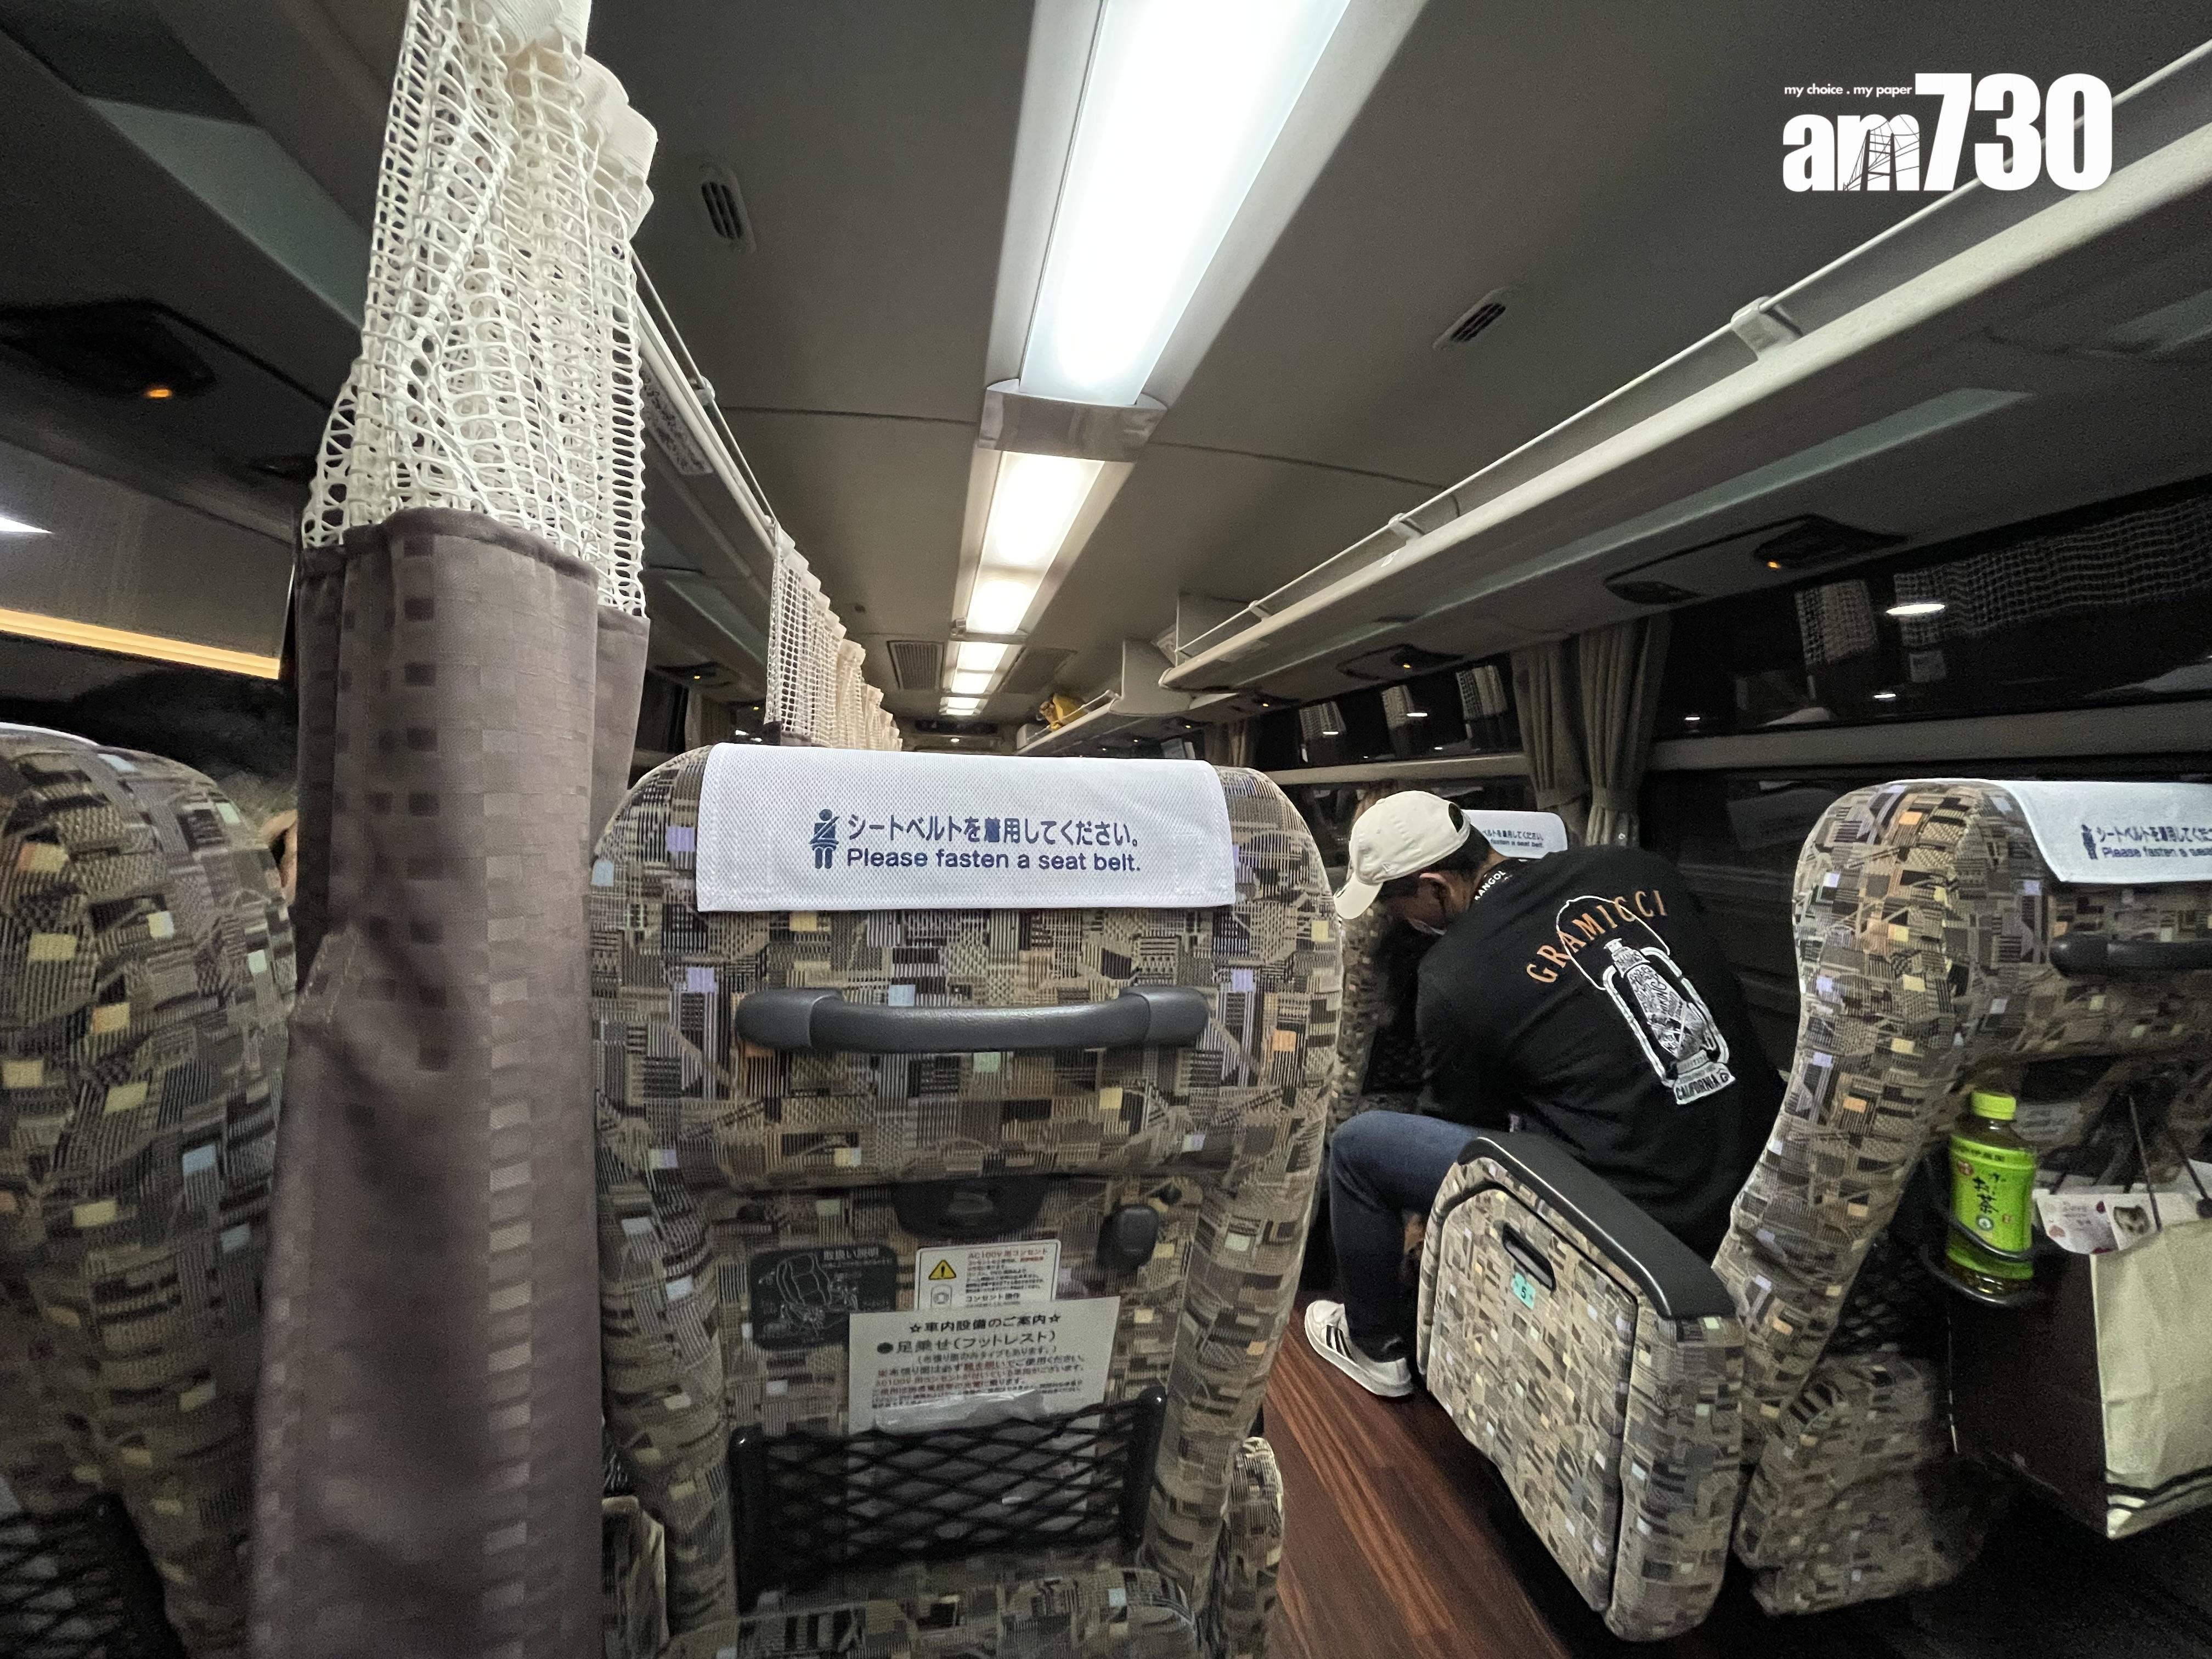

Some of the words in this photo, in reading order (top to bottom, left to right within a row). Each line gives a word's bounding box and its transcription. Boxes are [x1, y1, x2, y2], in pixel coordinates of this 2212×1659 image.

[848, 814, 1138, 847] シートベルトを着用してください。
[848, 848, 928, 867] Please
[935, 849, 1009, 868] fasten
[1017, 853, 1030, 869] a
[1039, 853, 1087, 870] seat
[1094, 853, 1141, 871] belt.
[1526, 890, 1668, 983] GRAMICCI
[1521, 1286, 1527, 1299] 5
